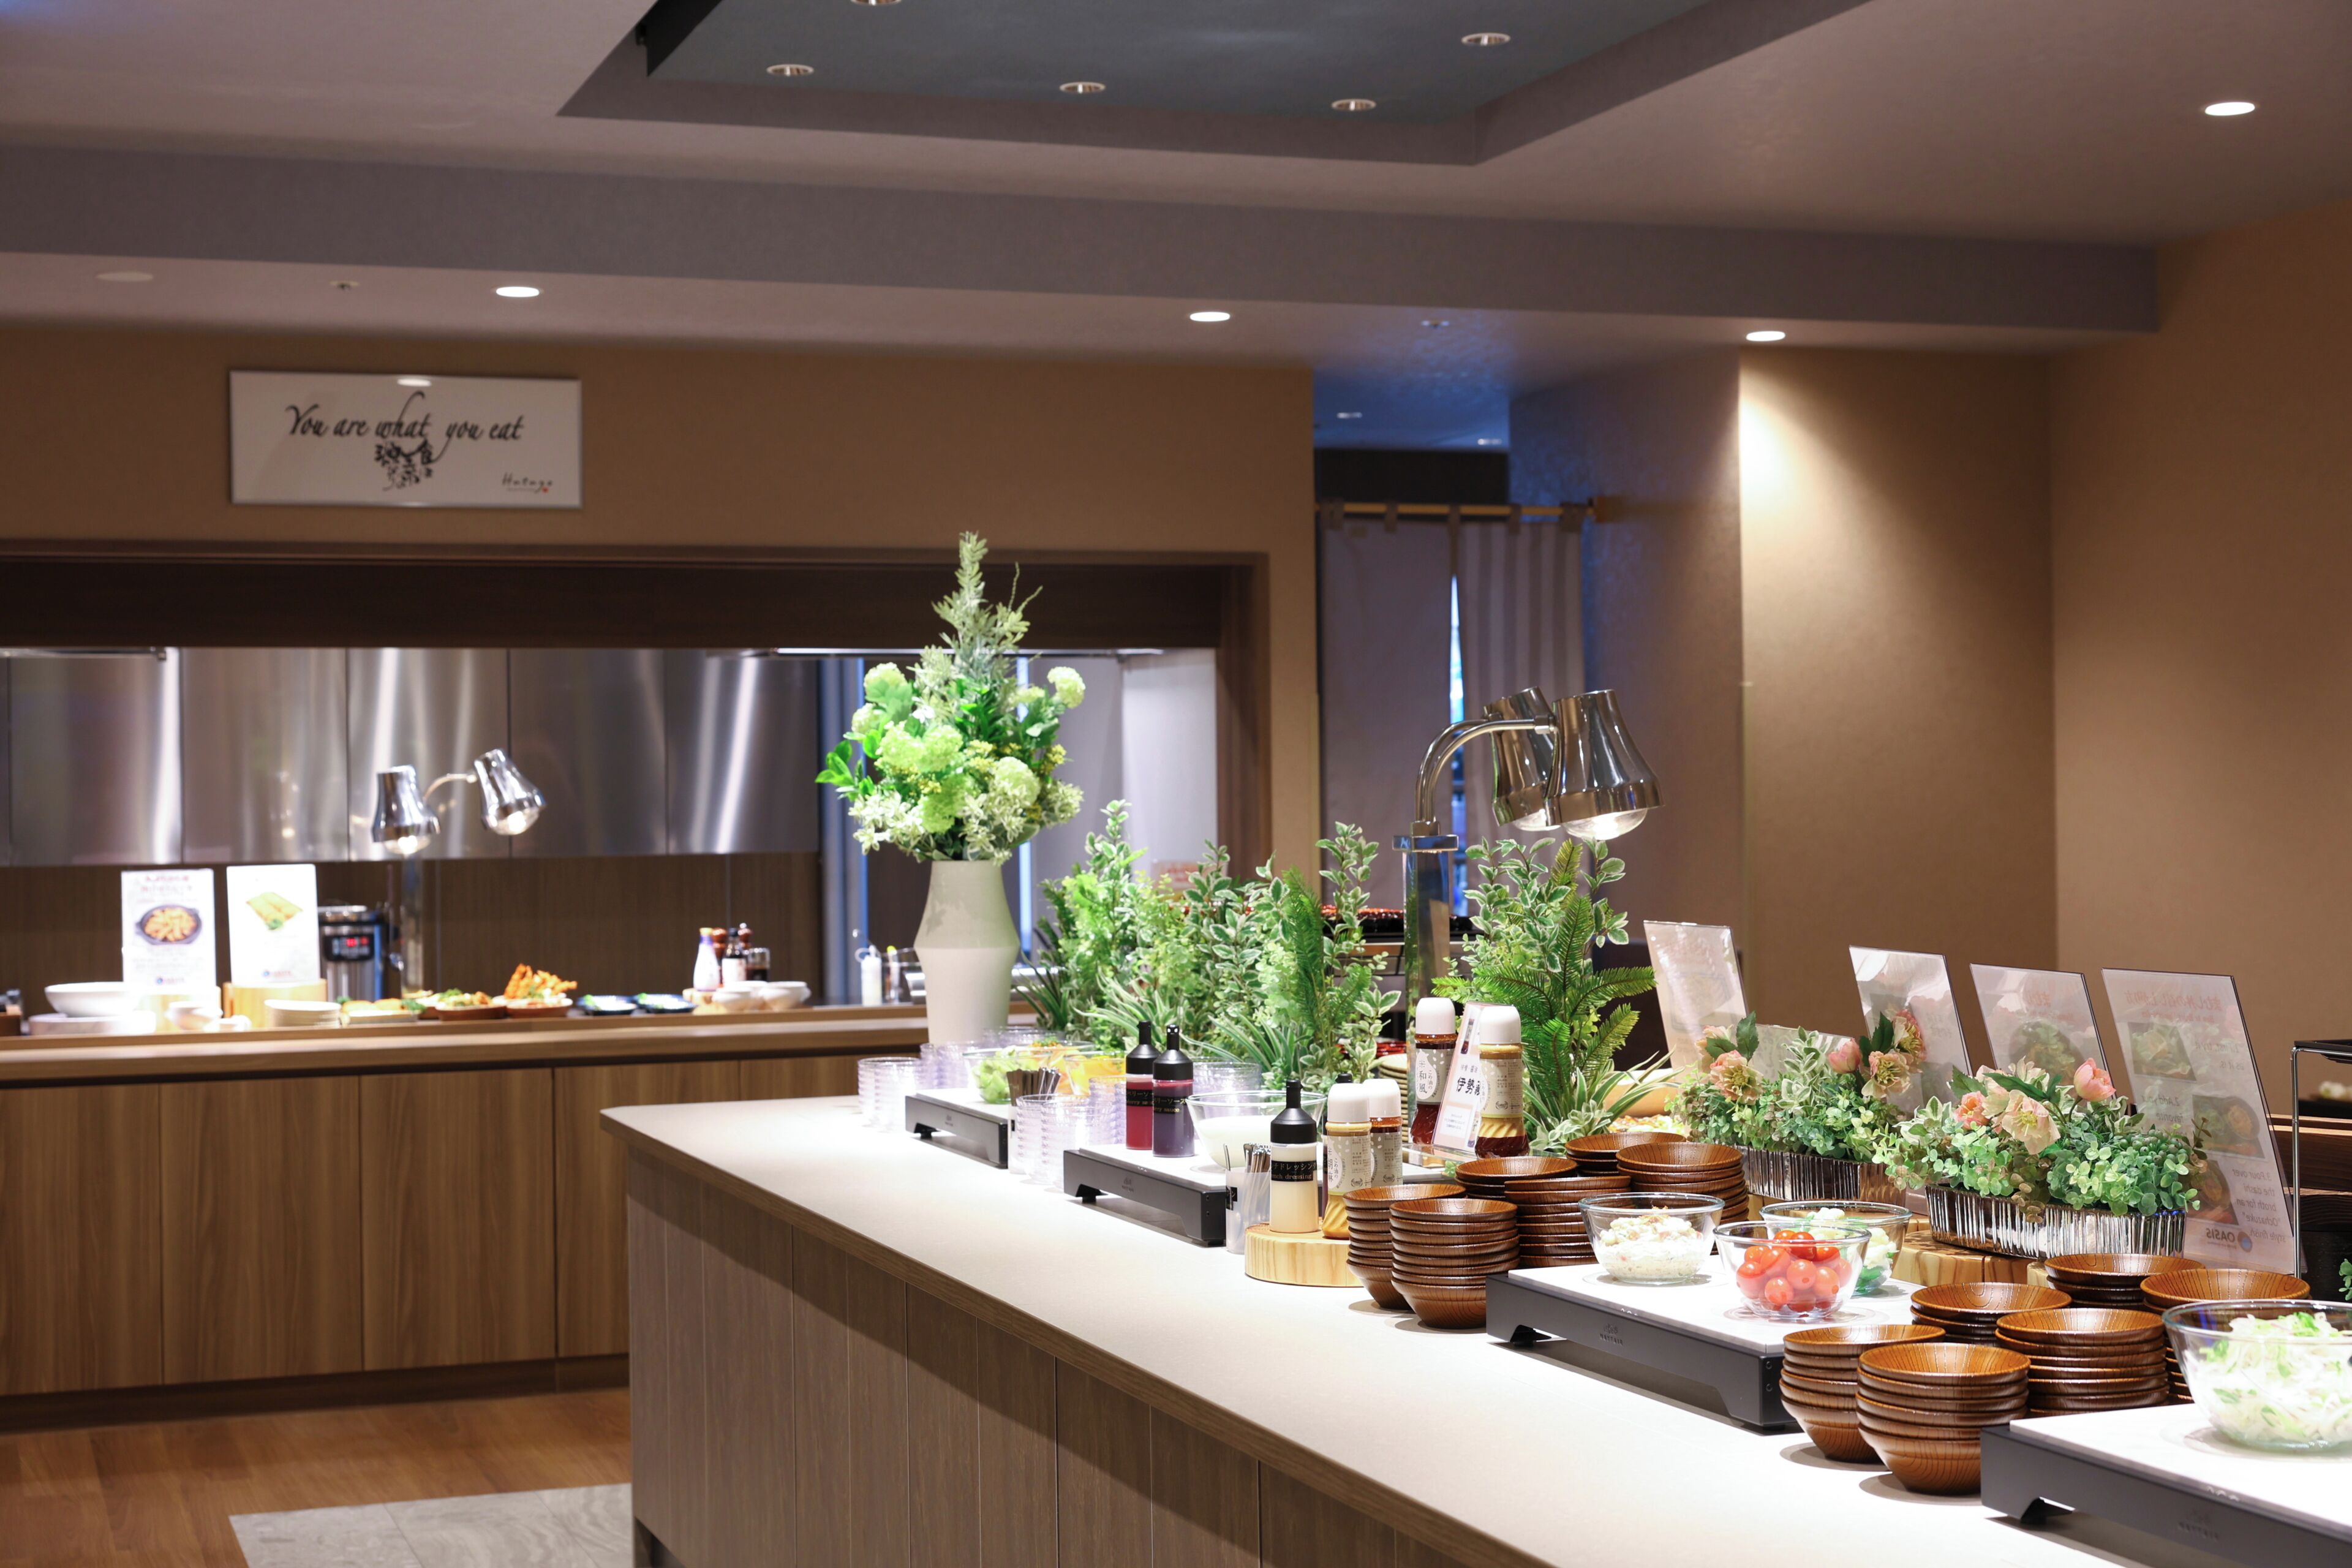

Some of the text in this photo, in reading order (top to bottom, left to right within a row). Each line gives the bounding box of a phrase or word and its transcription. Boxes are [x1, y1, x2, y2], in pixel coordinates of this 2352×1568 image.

[285, 403, 329, 437] You
[333, 418, 369, 437] are
[375, 391, 431, 438] what
[489, 414, 524, 440] eat
